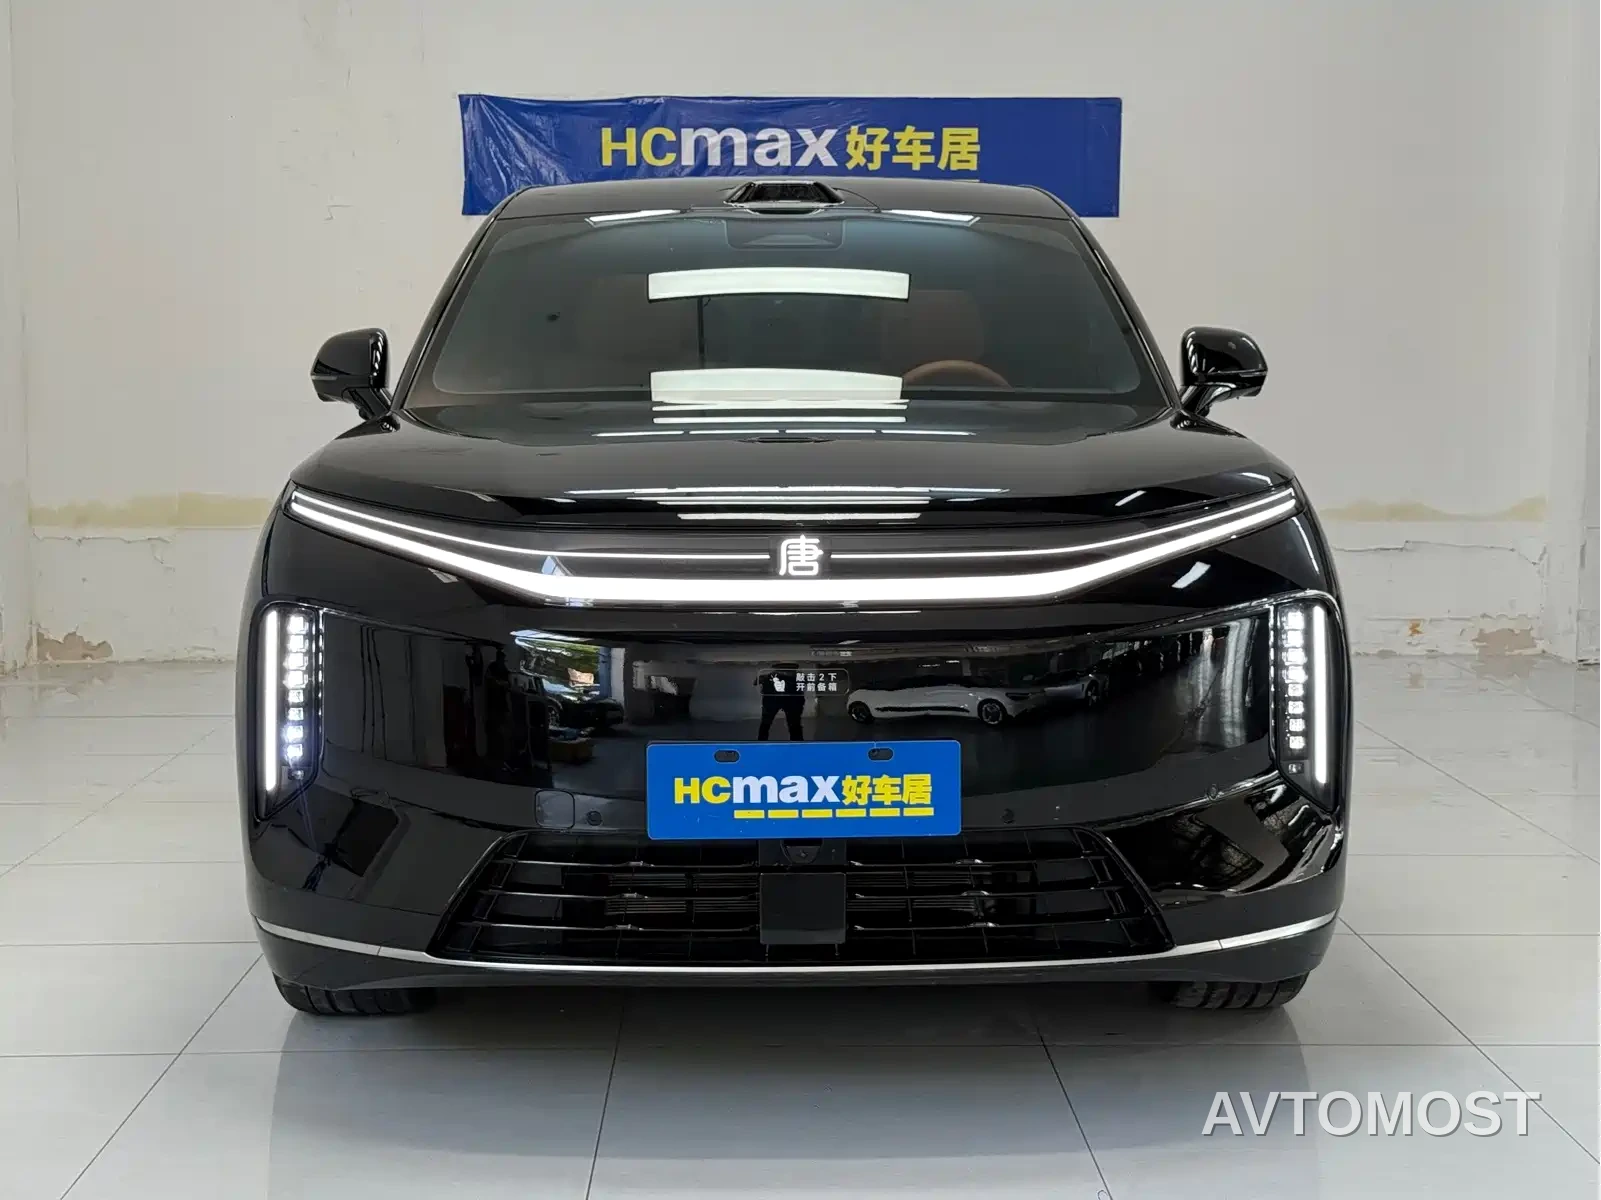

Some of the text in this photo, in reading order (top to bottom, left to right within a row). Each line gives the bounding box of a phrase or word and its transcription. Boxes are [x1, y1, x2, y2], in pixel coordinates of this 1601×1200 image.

[779, 534, 824, 576] 唐
[796, 682, 838, 691] 开前备箱
